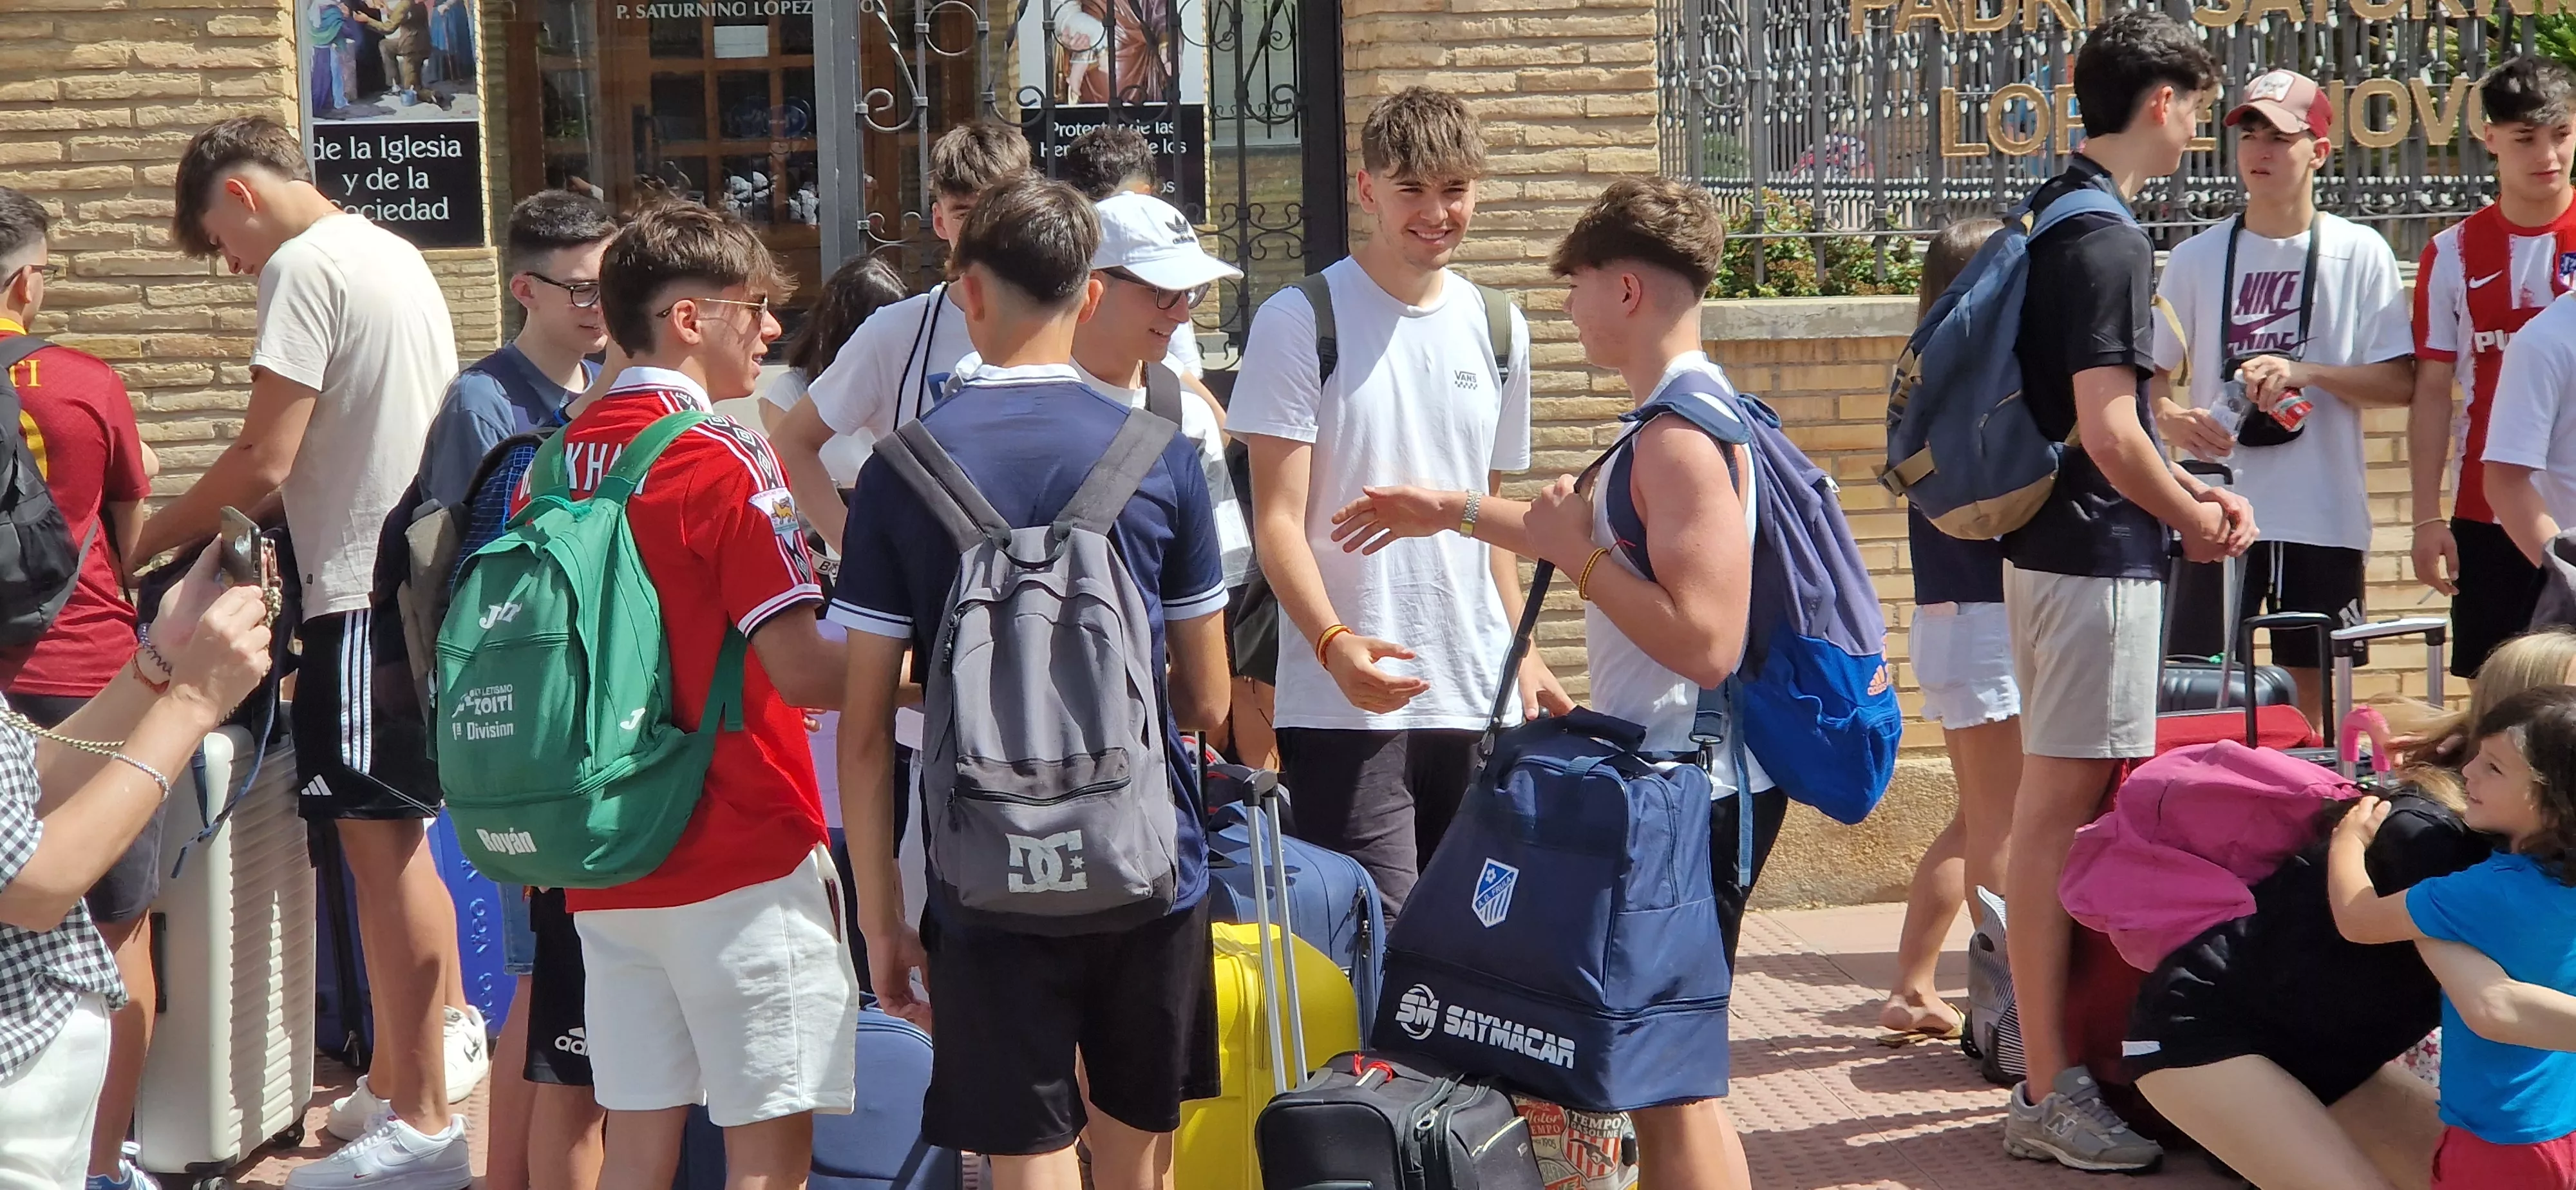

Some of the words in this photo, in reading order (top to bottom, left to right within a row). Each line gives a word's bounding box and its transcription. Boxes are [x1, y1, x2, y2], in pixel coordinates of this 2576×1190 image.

[616, 5, 630, 19] P.
[636, 2, 746, 19] SATURNINO
[754, 1, 813, 16] LOPEZ
[1155, 122, 1174, 135] las
[314, 137, 342, 160] de
[349, 136, 372, 159] la
[379, 134, 462, 164] Iglesia
[342, 173, 359, 196] y
[366, 167, 400, 191] de
[407, 165, 430, 189] la
[2234, 270, 2302, 316] NIKE
[1454, 370, 1477, 383] VANS
[1443, 1005, 1576, 1070] SAYMACAR
[1530, 1124, 1561, 1135] EMPO
[1571, 1110, 1622, 1130] TEMPO
[1570, 1122, 1619, 1139] GASOLINE
